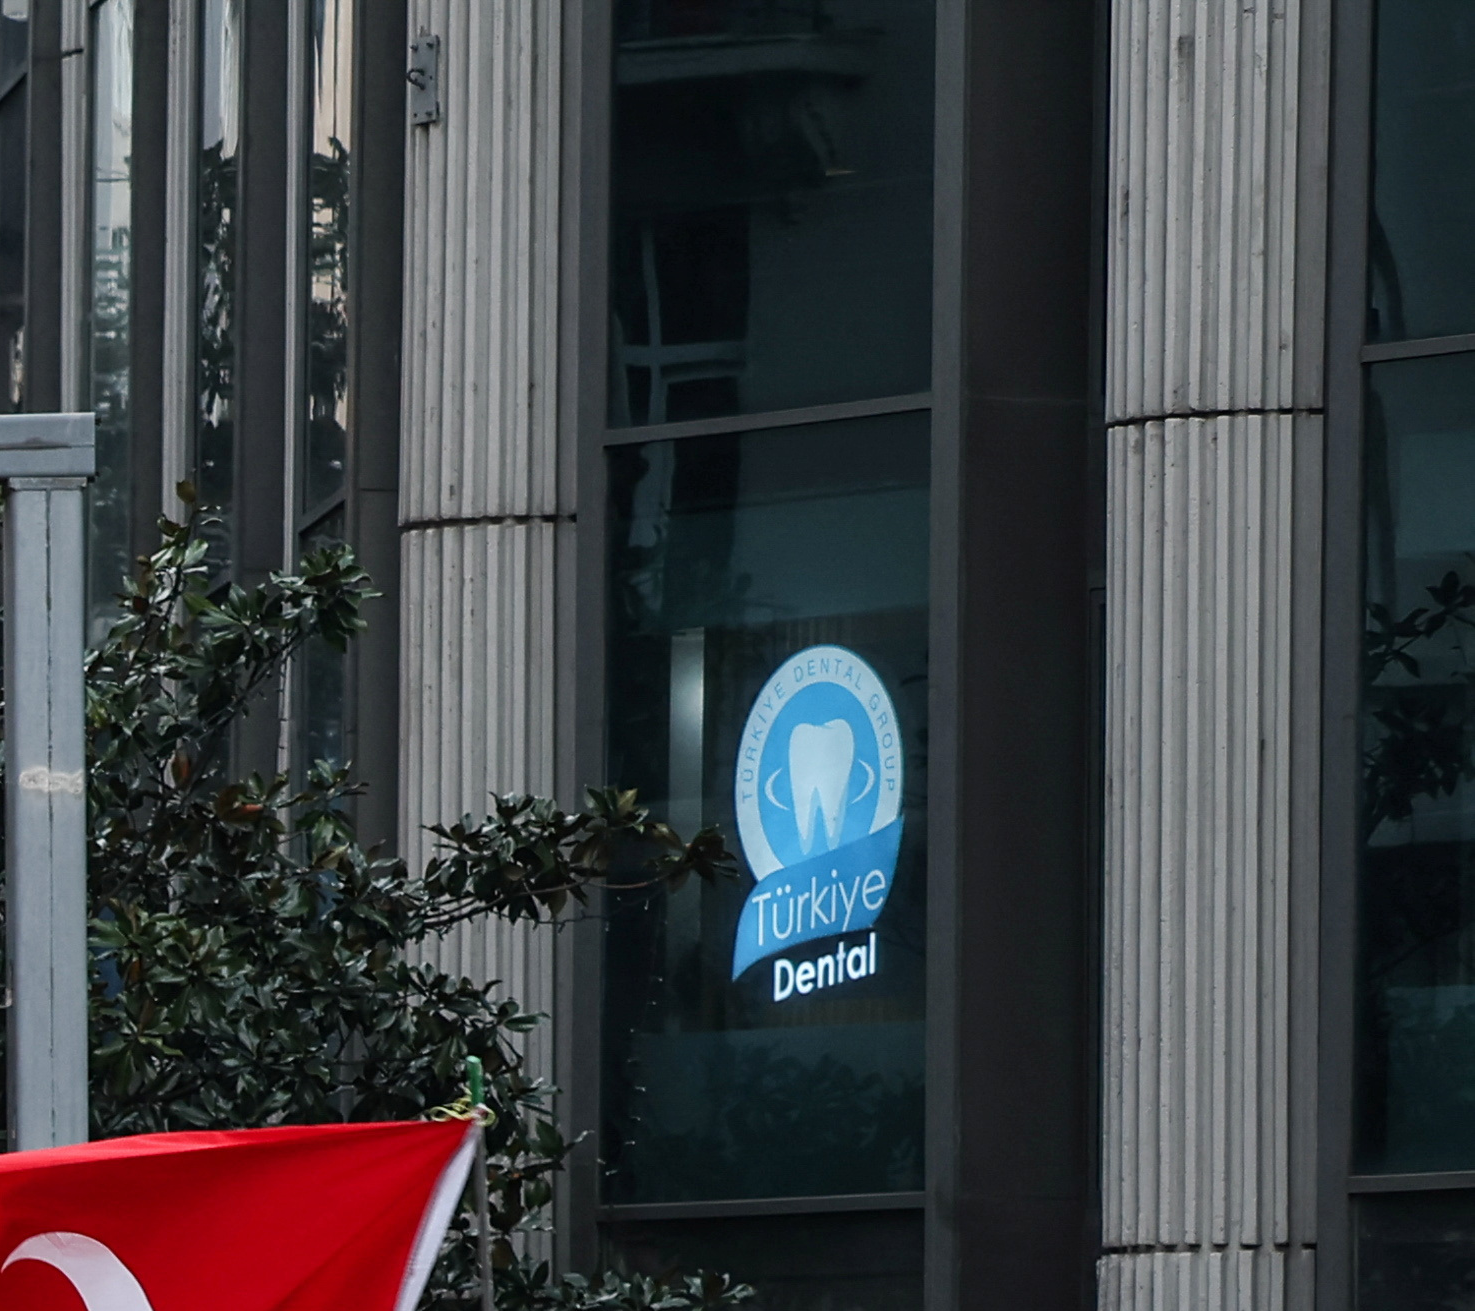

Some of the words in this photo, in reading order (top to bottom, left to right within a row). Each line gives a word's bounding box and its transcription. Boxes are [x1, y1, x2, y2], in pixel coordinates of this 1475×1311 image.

[794, 658, 862, 691] DENTAL
[870, 692, 896, 793] GROUP
[751, 868, 886, 947] Türkiye
[774, 931, 877, 1002] Dental
